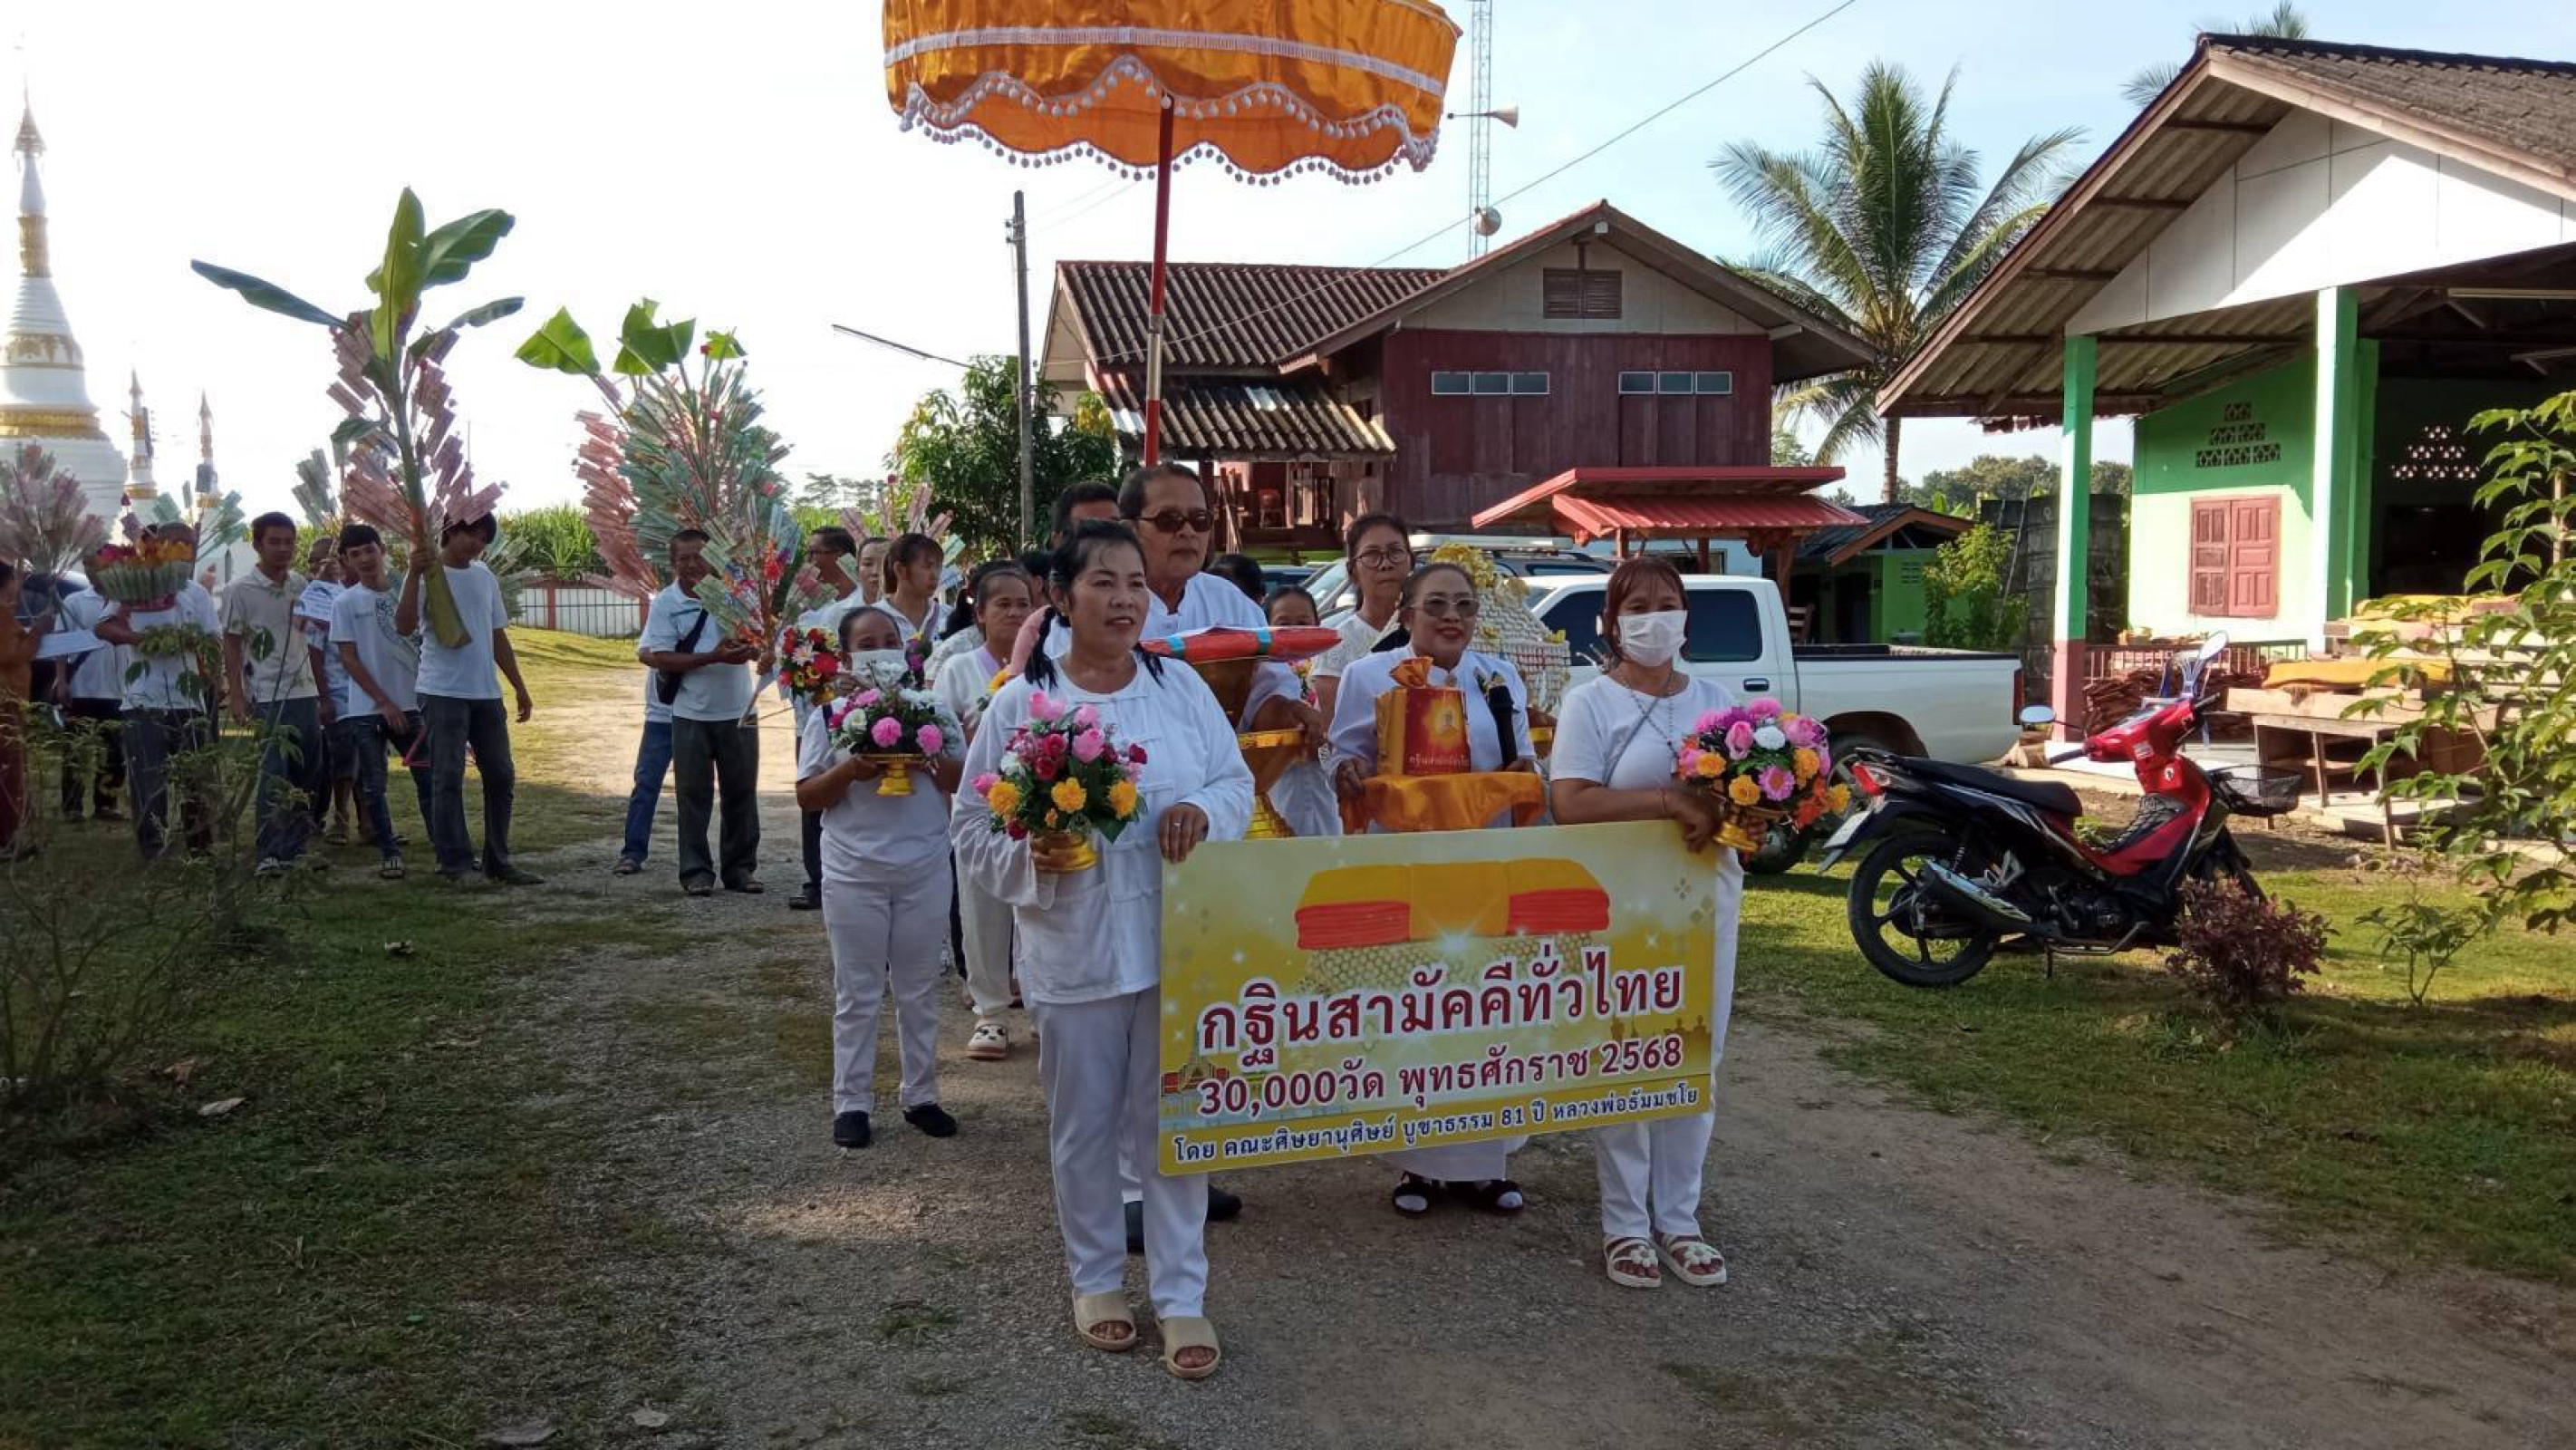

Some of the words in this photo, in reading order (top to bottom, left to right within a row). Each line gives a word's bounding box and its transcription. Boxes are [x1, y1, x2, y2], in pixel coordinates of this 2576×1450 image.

[1201, 943, 1683, 1067] กฐินสามัคคีทั่วไทย
[1199, 1057, 1385, 1117] 30,000วัด
[1399, 1044, 1587, 1107] พุทธศักราช
[1601, 1037, 1683, 1073] 2568
[1174, 1136, 1216, 1161] โดย
[1224, 1116, 1395, 1157] คณะศิษยานุศิษย์
[1501, 1107, 1523, 1126] 81
[1533, 1099, 1546, 1122] ปี
